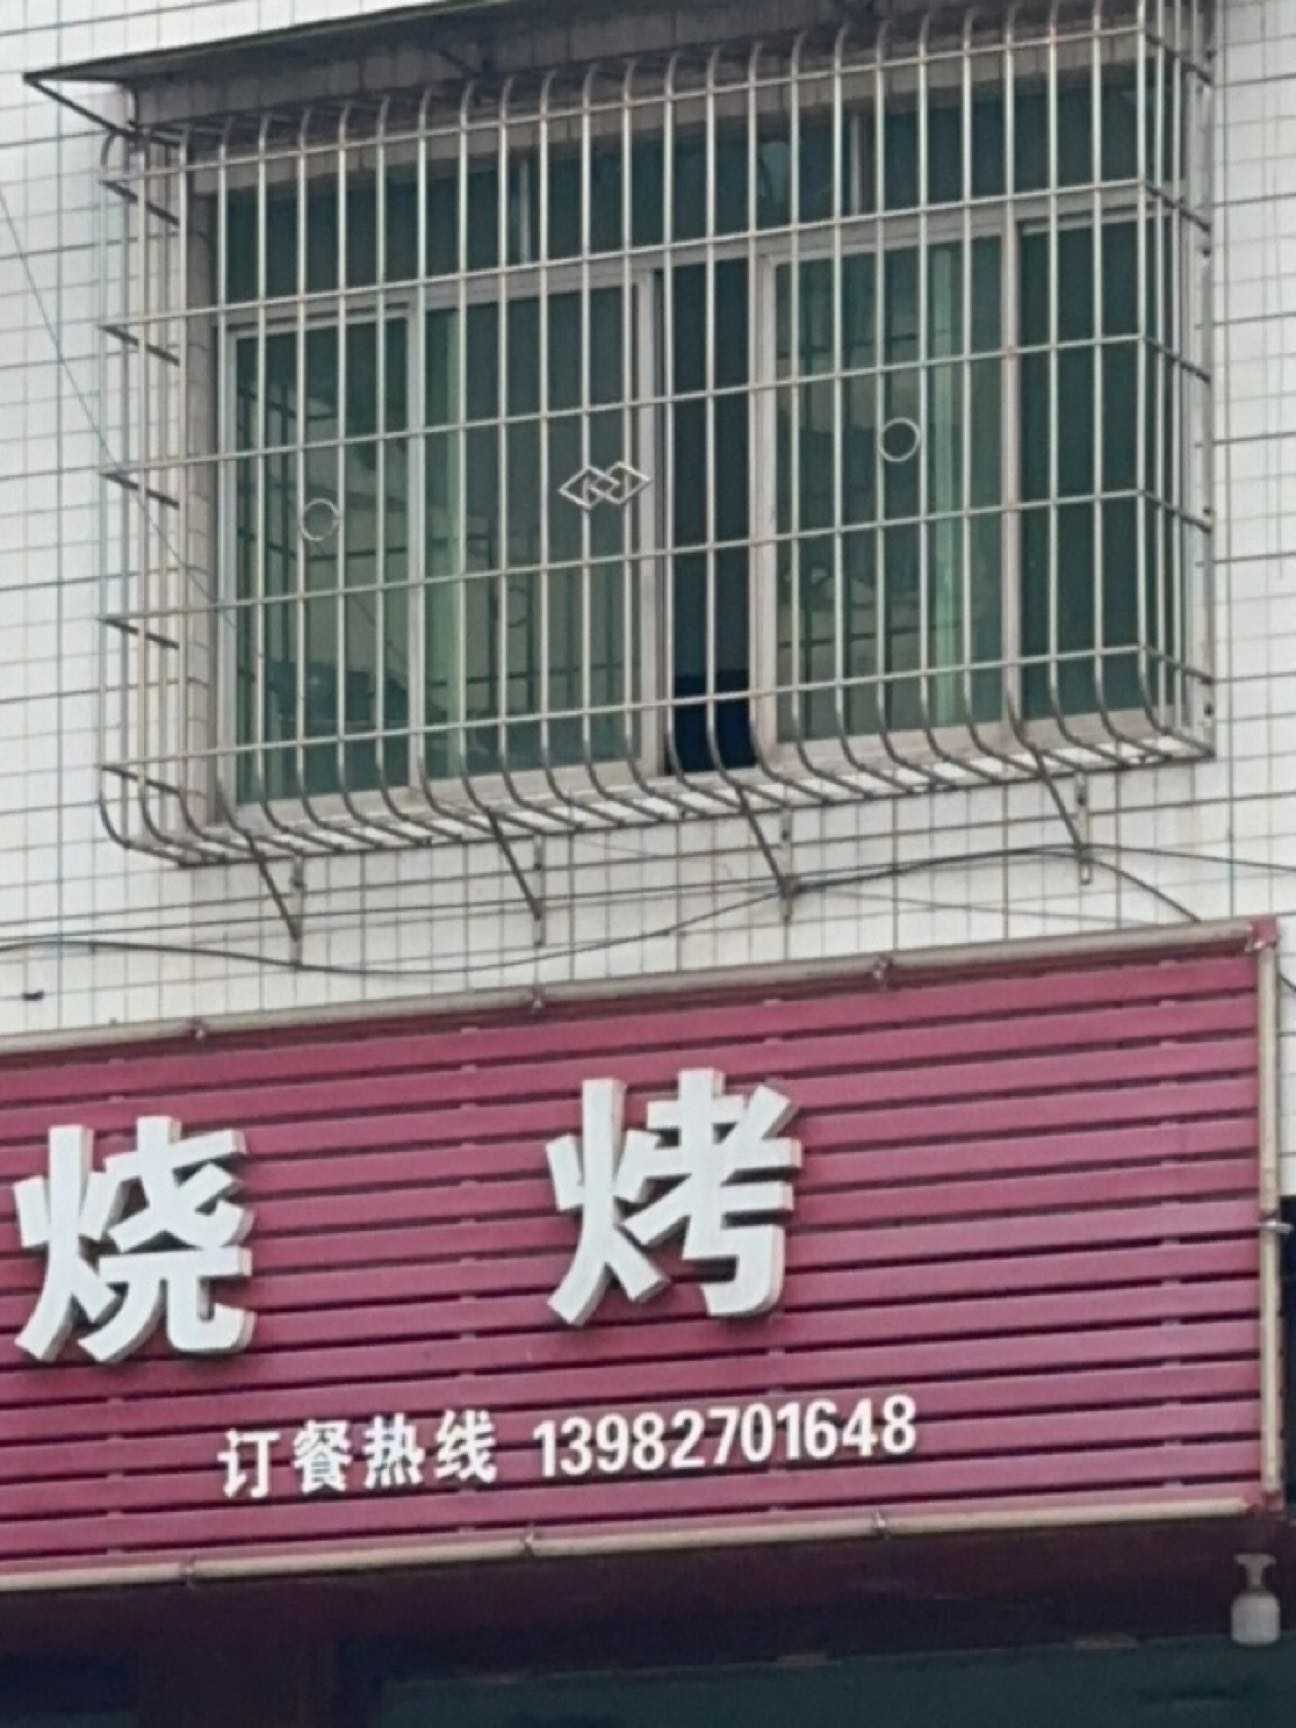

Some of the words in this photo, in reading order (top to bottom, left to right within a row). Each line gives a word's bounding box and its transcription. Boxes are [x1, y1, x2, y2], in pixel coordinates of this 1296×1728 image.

[216, 1408, 497, 1499] 订餐热线
[531, 1394, 916, 1478] 13982701648
